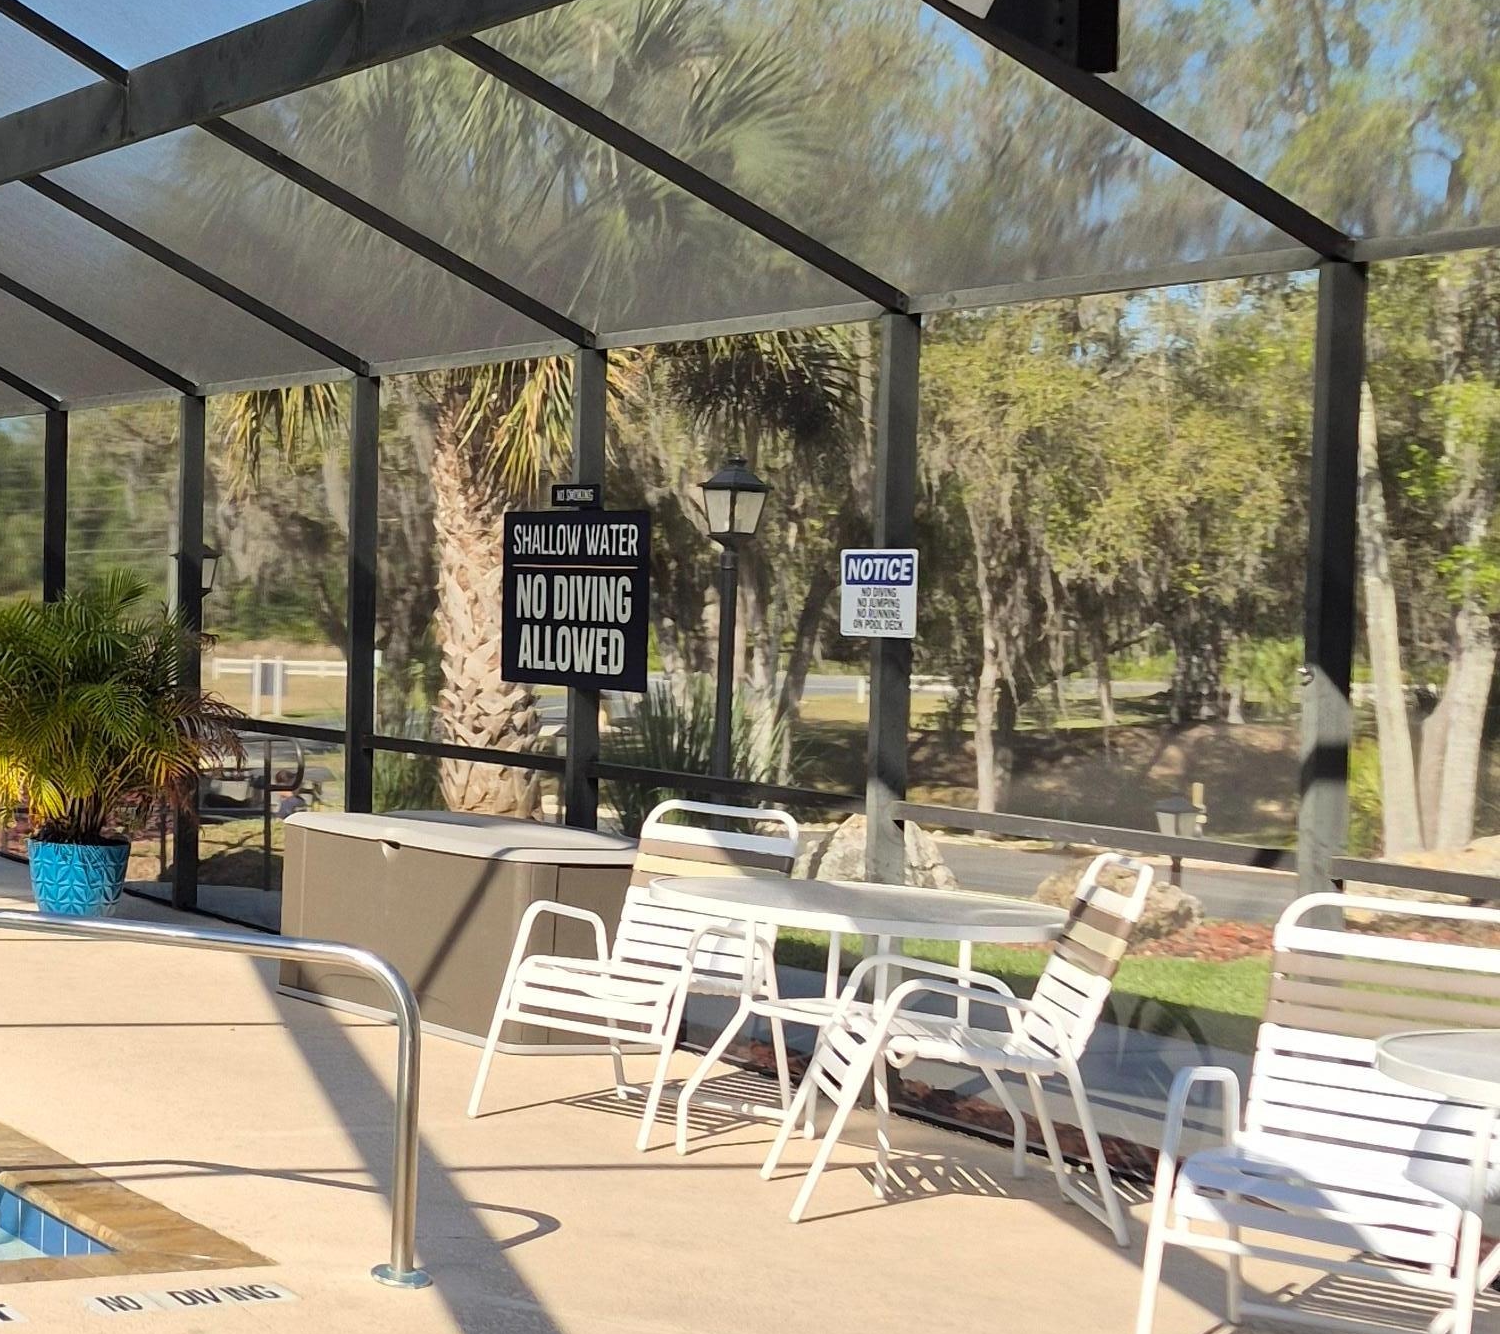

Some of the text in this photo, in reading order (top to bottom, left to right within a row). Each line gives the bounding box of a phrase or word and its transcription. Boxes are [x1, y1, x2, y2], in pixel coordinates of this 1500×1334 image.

[512, 524, 639, 556] SHALLOW WATER
[846, 557, 913, 581] NOTICE
[516, 573, 633, 624] NO DIVING
[517, 624, 626, 675] ALLOWED
[95, 1284, 281, 1312] NO DIVING
